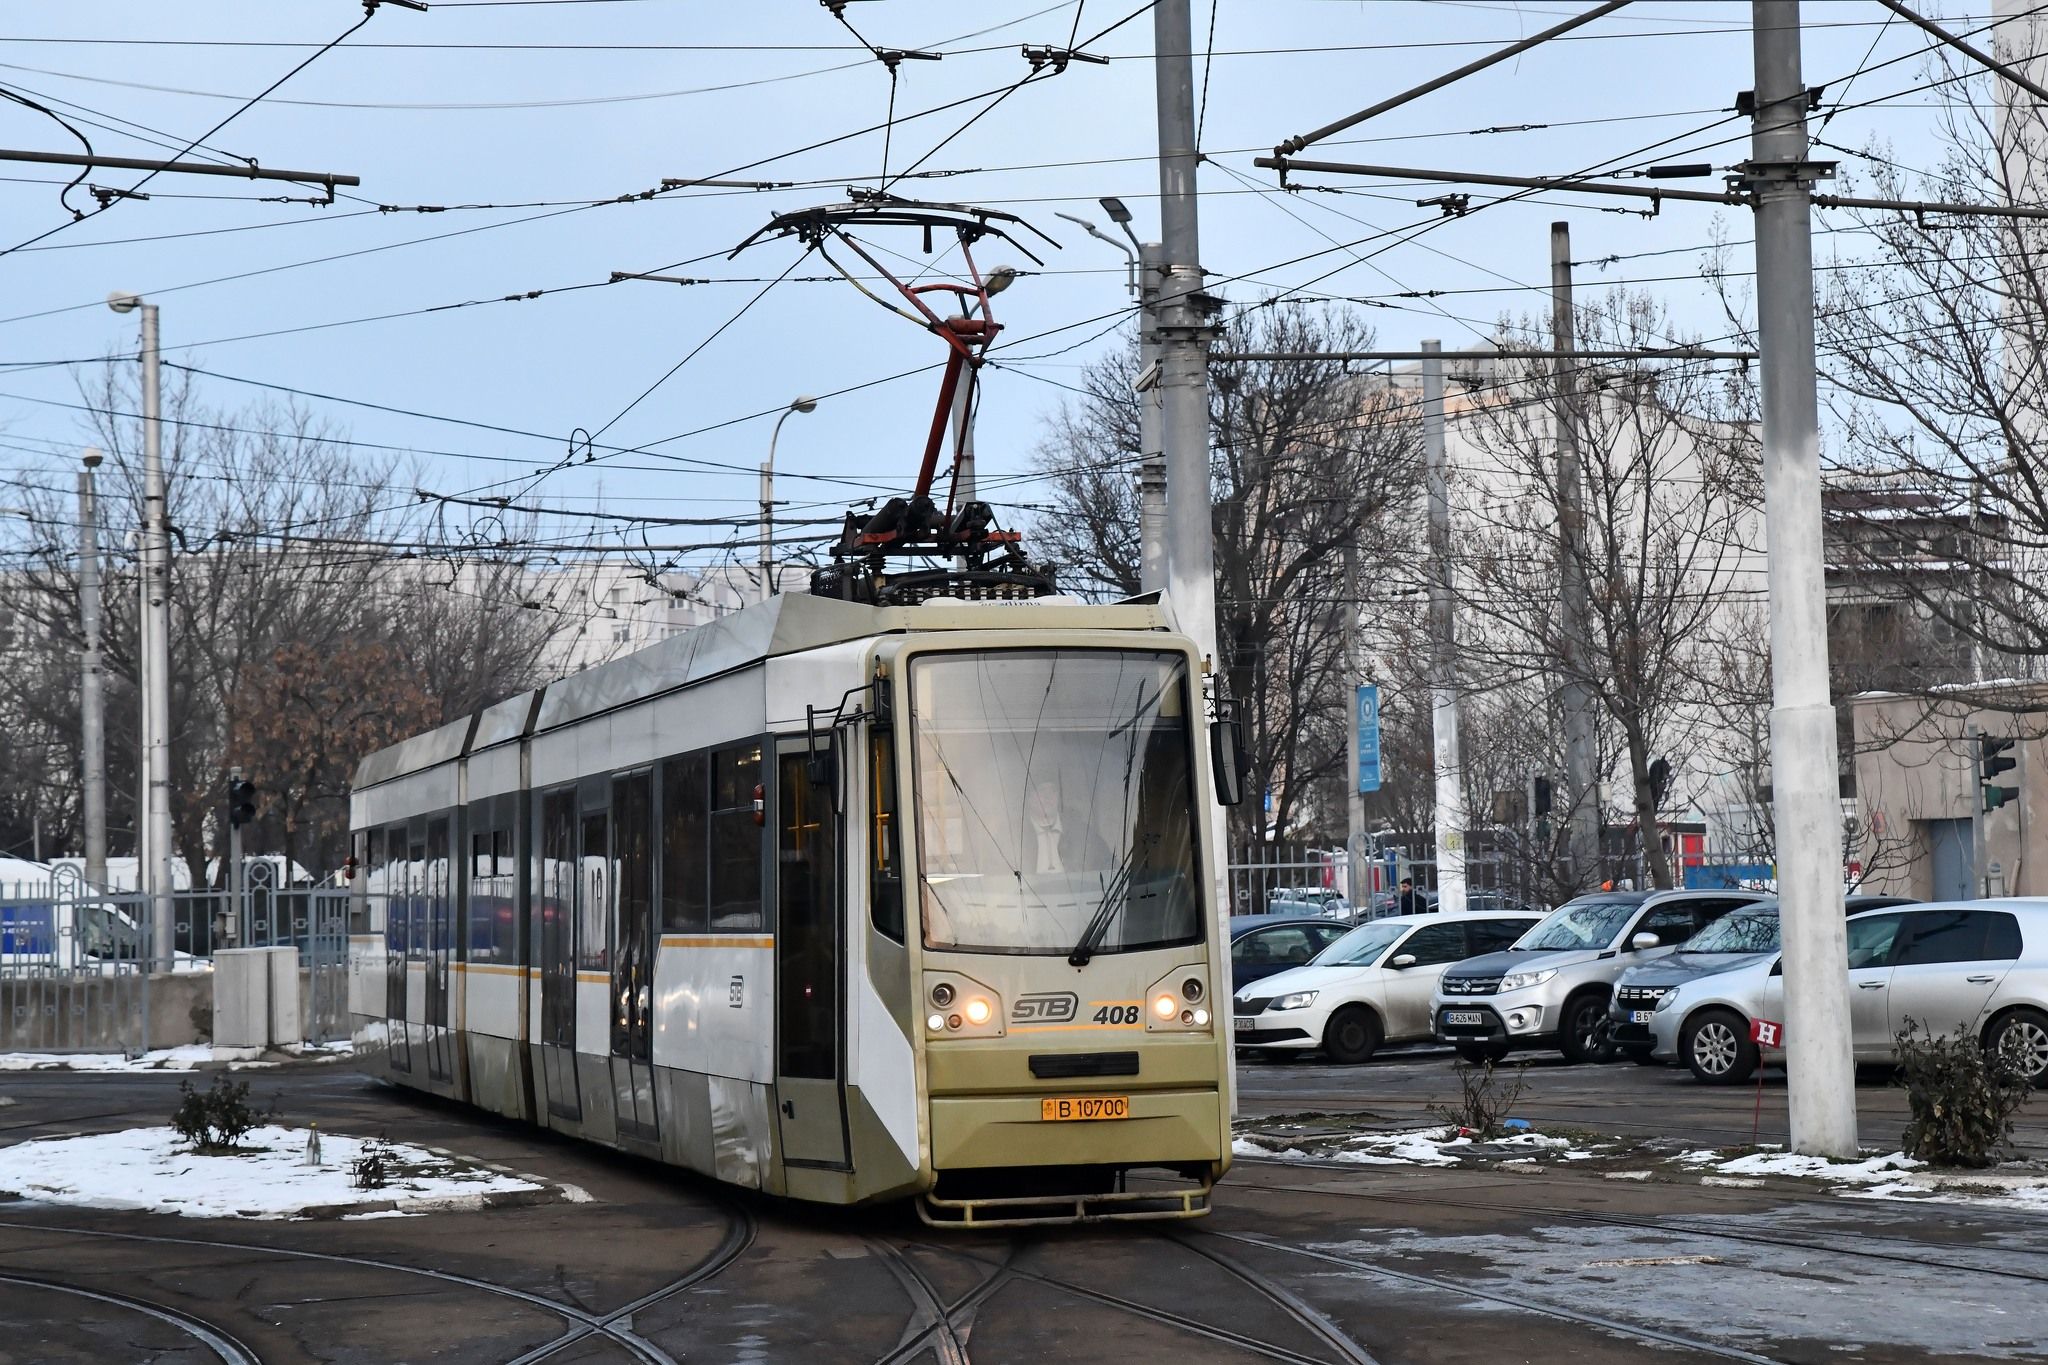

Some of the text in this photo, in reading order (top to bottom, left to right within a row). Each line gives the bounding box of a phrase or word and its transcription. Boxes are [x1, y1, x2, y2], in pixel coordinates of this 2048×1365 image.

[1011, 997, 1072, 1018] STB
[1093, 1005, 1139, 1025] 408
[1636, 1012, 1641, 1021] B
[1756, 1021, 1777, 1046] H
[1059, 1099, 1124, 1118] B 10700
